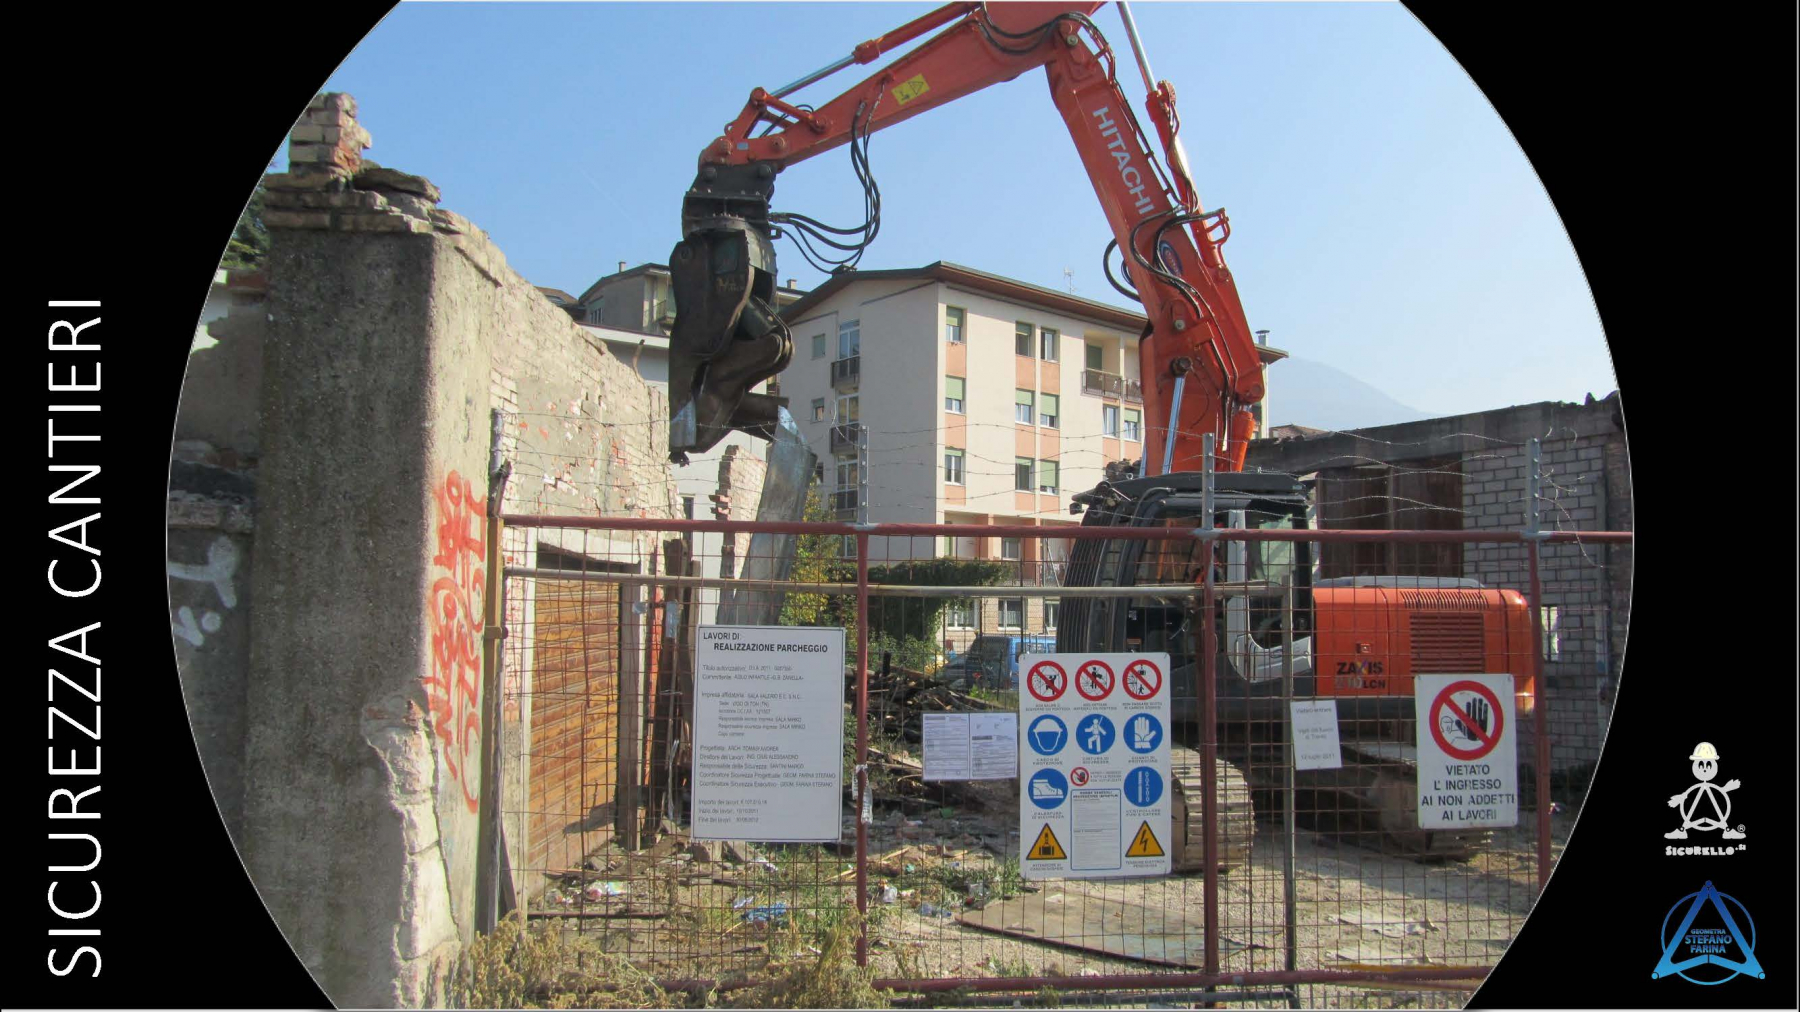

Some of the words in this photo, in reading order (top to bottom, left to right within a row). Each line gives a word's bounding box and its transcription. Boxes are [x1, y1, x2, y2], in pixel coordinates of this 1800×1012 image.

[1092, 106, 1155, 215] HITACHI
[703, 632, 730, 640] LAVORI
[714, 643, 775, 652] REALIZZAZIONE
[776, 644, 828, 653] PARCHEGGIO
[1337, 660, 1383, 675] ZAXIS
[1446, 764, 1490, 776] VIETATO
[1445, 779, 1502, 790] INGRESSO
[1421, 795, 1433, 806] AI
[1438, 795, 1463, 806] NON
[1468, 794, 1515, 805] ADDETTI
[1442, 811, 1453, 821] AI
[1458, 809, 1497, 821] LAVORI
